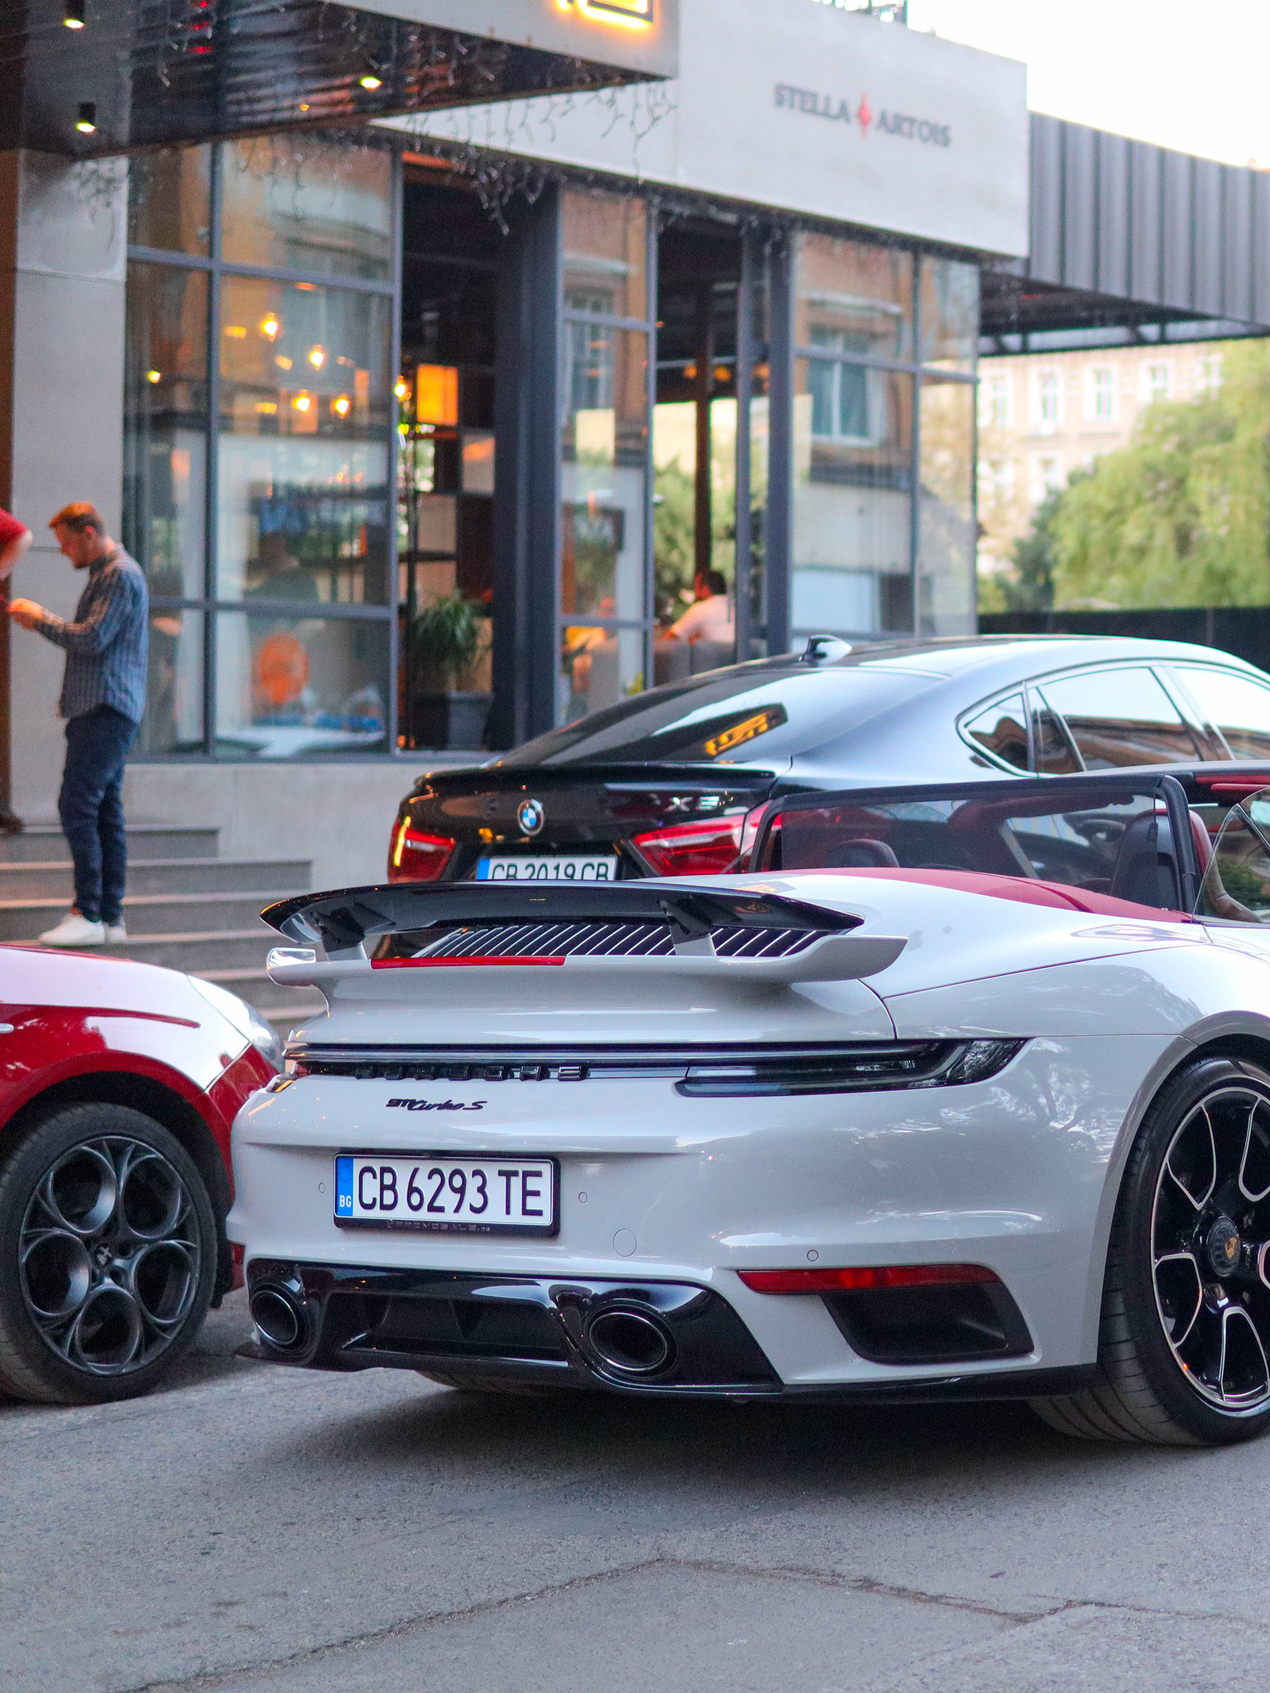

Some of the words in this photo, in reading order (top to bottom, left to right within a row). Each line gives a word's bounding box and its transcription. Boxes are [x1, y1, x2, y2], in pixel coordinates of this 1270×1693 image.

[774, 83, 851, 124] STELLA
[876, 109, 951, 147] ARTOIS
[339, 1195, 352, 1208] BG
[358, 1166, 399, 1211] CB
[406, 1167, 489, 1214] 6293
[498, 1170, 544, 1217] TE
